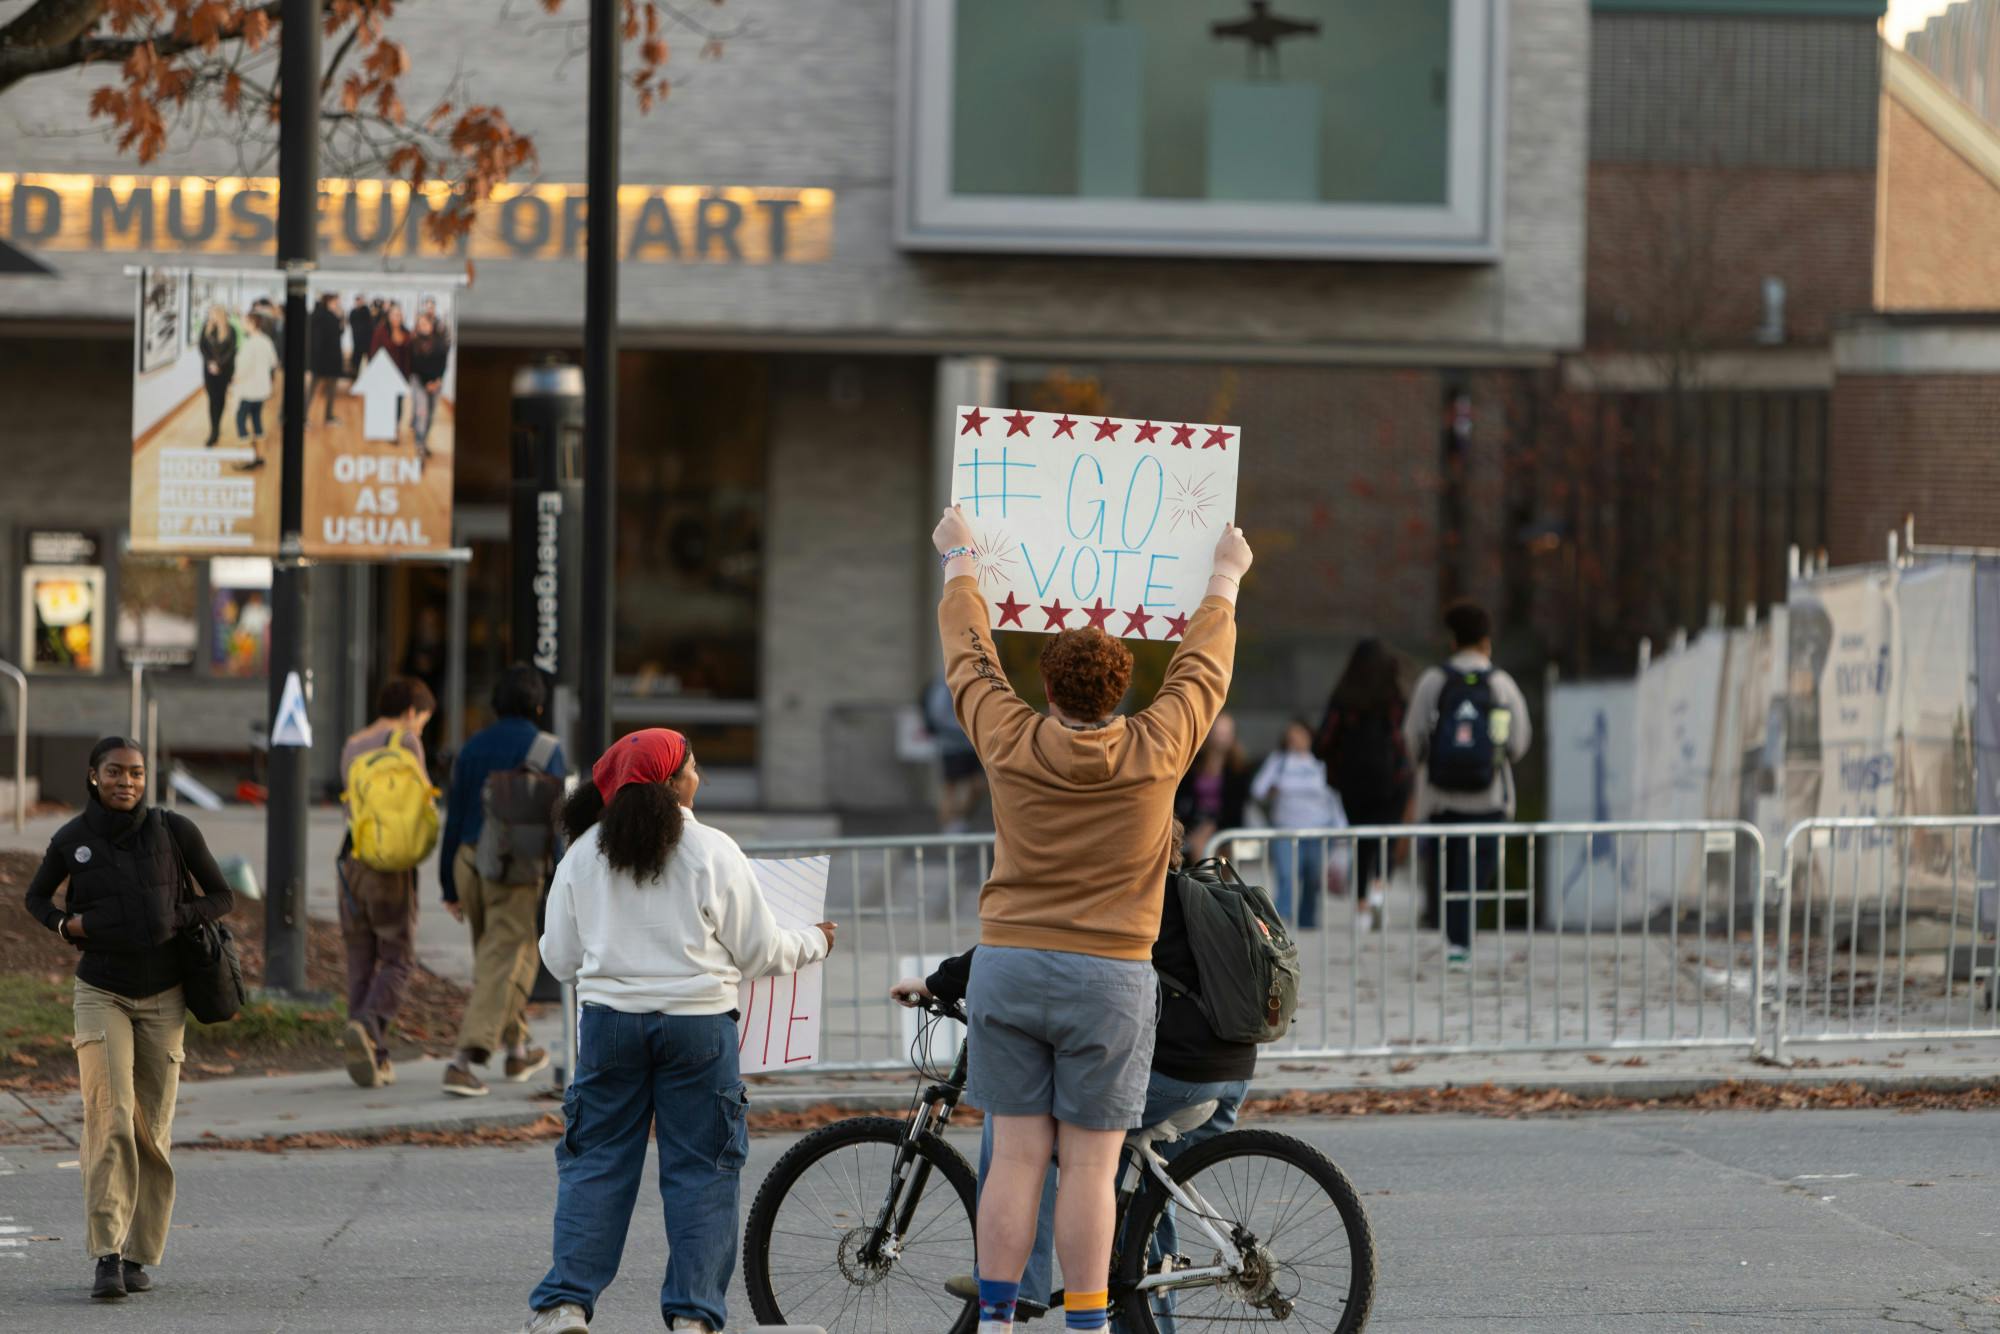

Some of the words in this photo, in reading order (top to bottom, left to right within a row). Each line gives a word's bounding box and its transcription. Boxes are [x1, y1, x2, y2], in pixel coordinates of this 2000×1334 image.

[626, 196, 802, 262] ART
[333, 455, 422, 483] OPEN
[355, 487, 399, 514] AS
[188, 512, 236, 536] ART
[322, 516, 431, 546] USUAL
[532, 491, 563, 674] Emergency
[1020, 542, 1179, 607] VOTE
